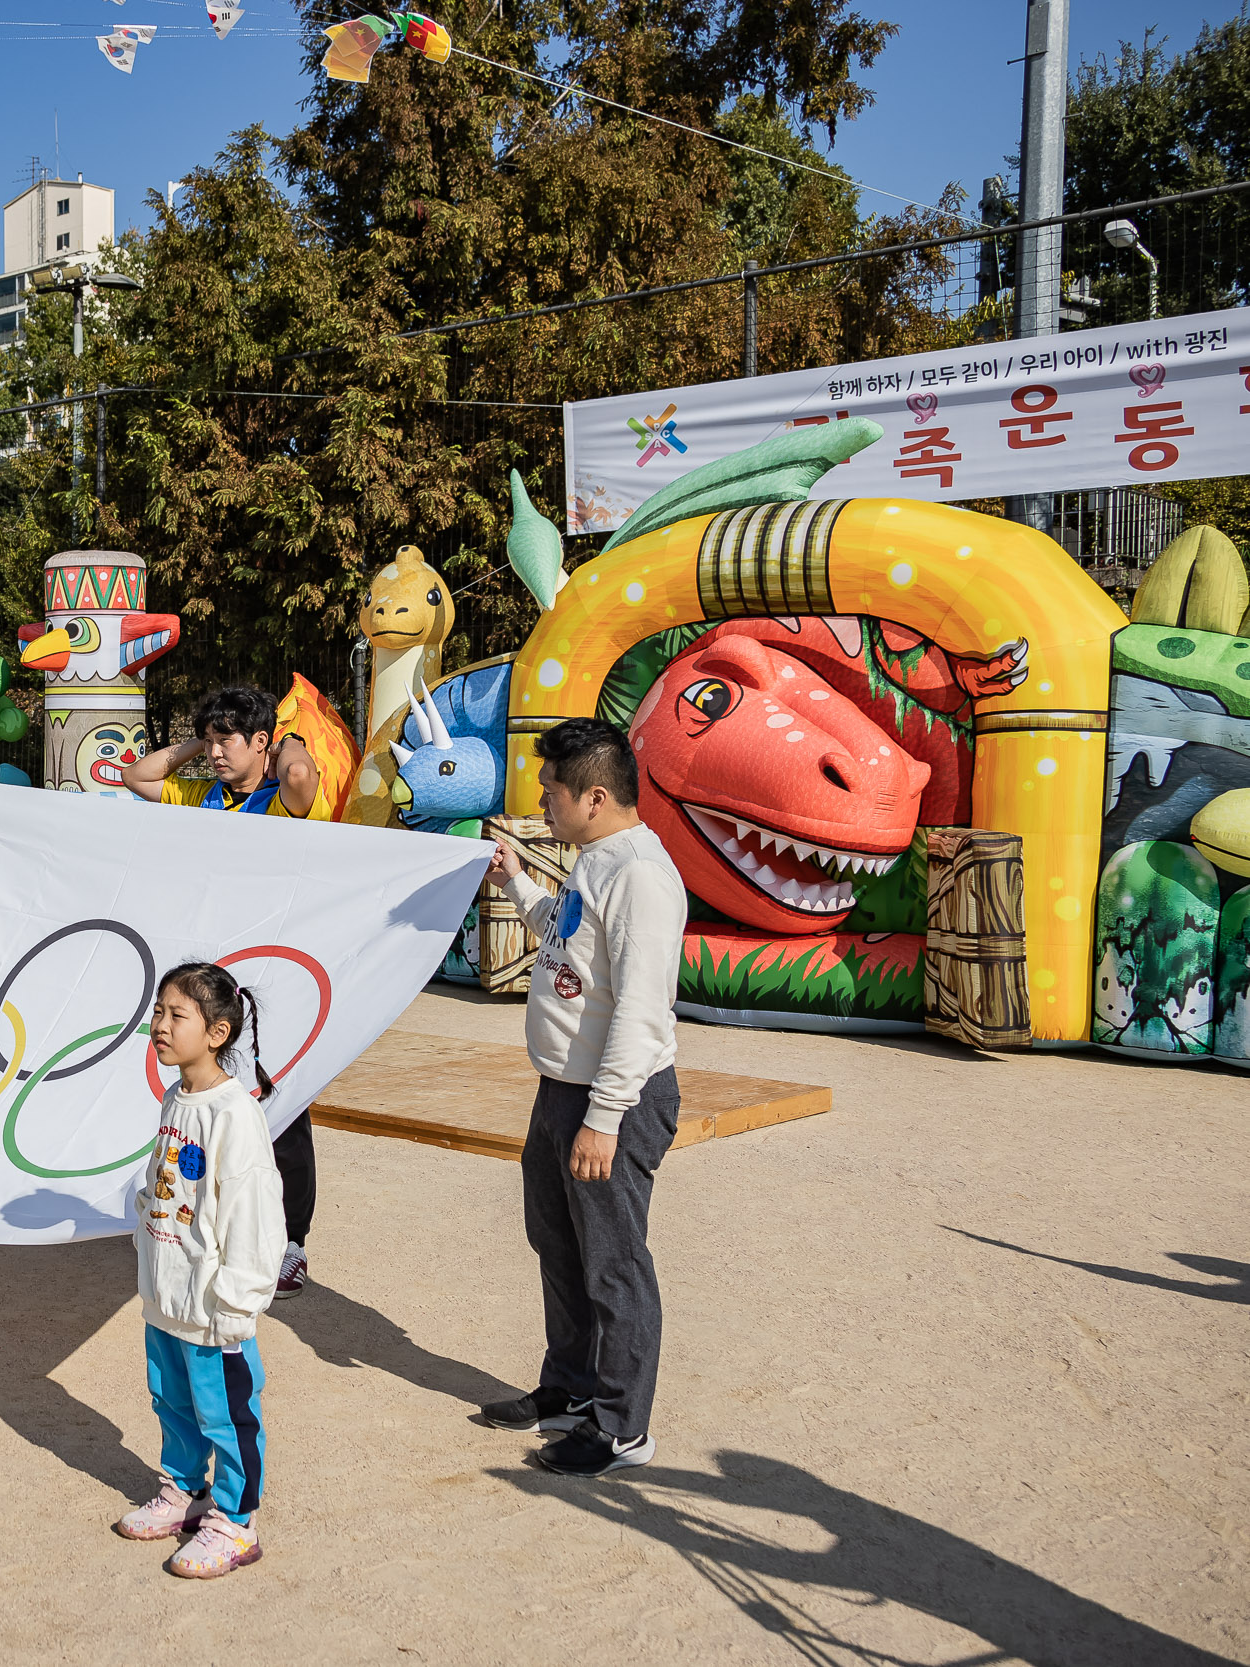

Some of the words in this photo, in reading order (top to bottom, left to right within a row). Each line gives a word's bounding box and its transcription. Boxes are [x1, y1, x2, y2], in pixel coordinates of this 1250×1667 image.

[827, 377, 863, 401] 함께
[865, 372, 903, 395] 하자
[906, 370, 915, 390] /
[920, 365, 958, 388] 모두
[961, 358, 999, 384] 같이
[1004, 356, 1014, 378] /
[1018, 349, 1057, 375] 우리
[1063, 344, 1103, 369] 아이
[1109, 342, 1120, 364] /
[1126, 336, 1178, 360] with
[1184, 327, 1228, 355] 광진
